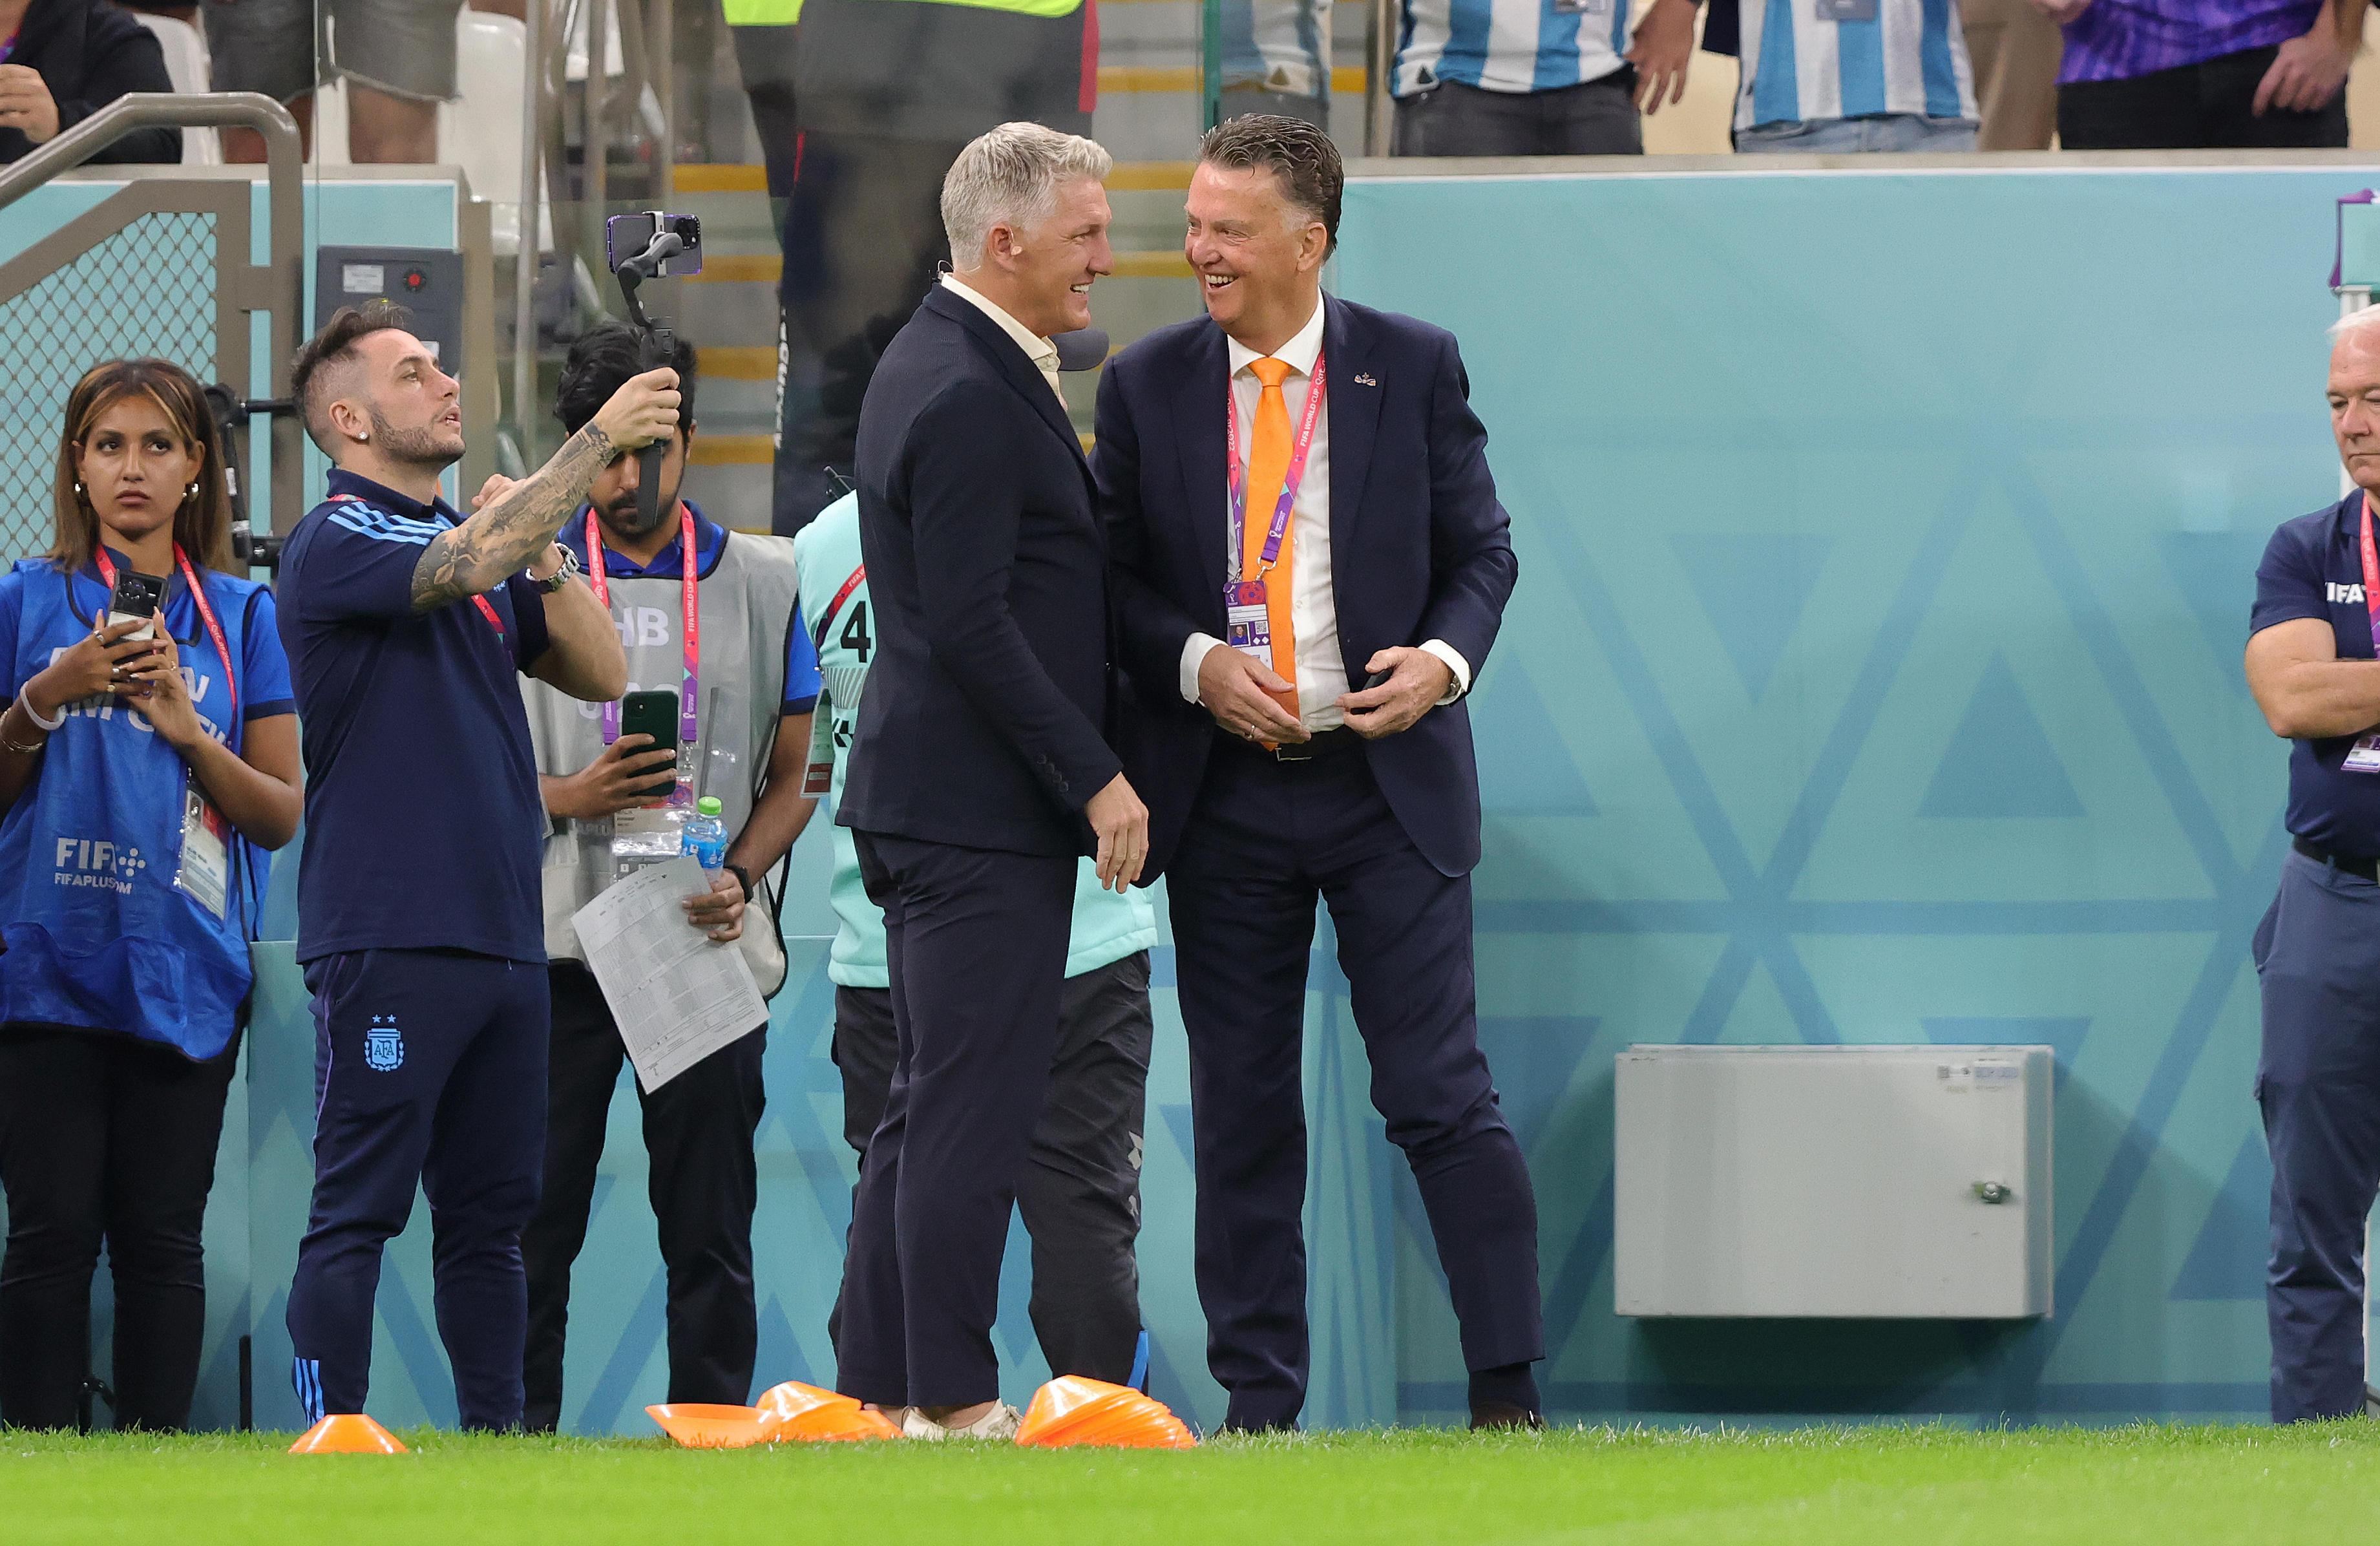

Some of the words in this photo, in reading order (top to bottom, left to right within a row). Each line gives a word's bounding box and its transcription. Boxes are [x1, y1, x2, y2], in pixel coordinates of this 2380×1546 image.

[1310, 388, 1320, 403] CUP
[1303, 403, 1316, 430] WORLD
[1299, 430, 1309, 447] FIFA
[2325, 582, 2365, 605] IFA
[841, 600, 871, 662] 4
[374, 1039, 394, 1059] AFA
